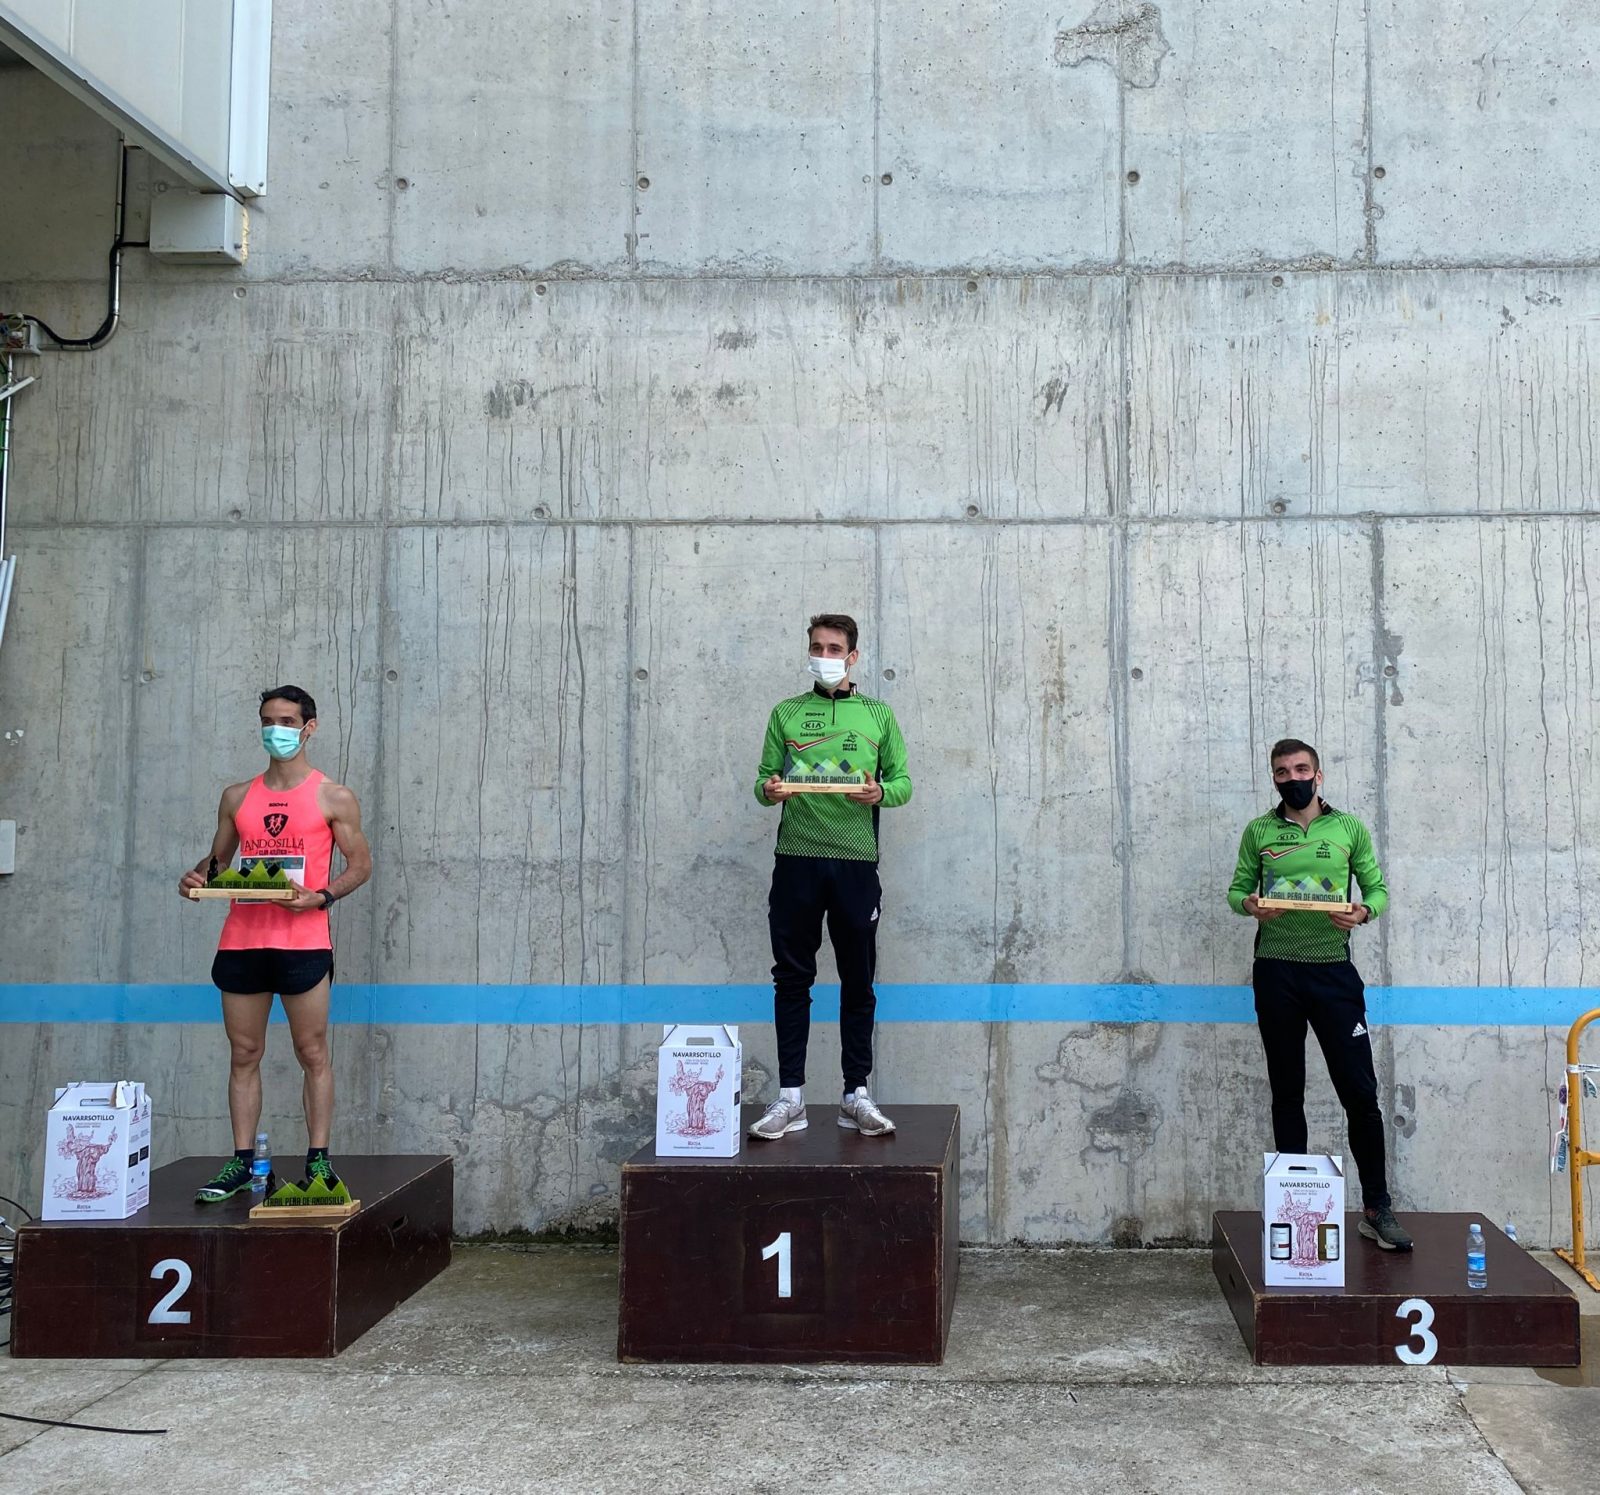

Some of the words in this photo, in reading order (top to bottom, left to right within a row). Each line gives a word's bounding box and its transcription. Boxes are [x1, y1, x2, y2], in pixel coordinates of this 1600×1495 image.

[821, 775, 829, 784] DE
[830, 775, 861, 785] ANDOSILLA
[245, 837, 305, 852] ANDOSILLA
[1303, 893, 1311, 901] DE
[1311, 893, 1343, 903] ANDOSILLA
[762, 1232, 791, 1298] 1
[147, 1258, 192, 1324] 2
[1395, 1298, 1438, 1365] 3
